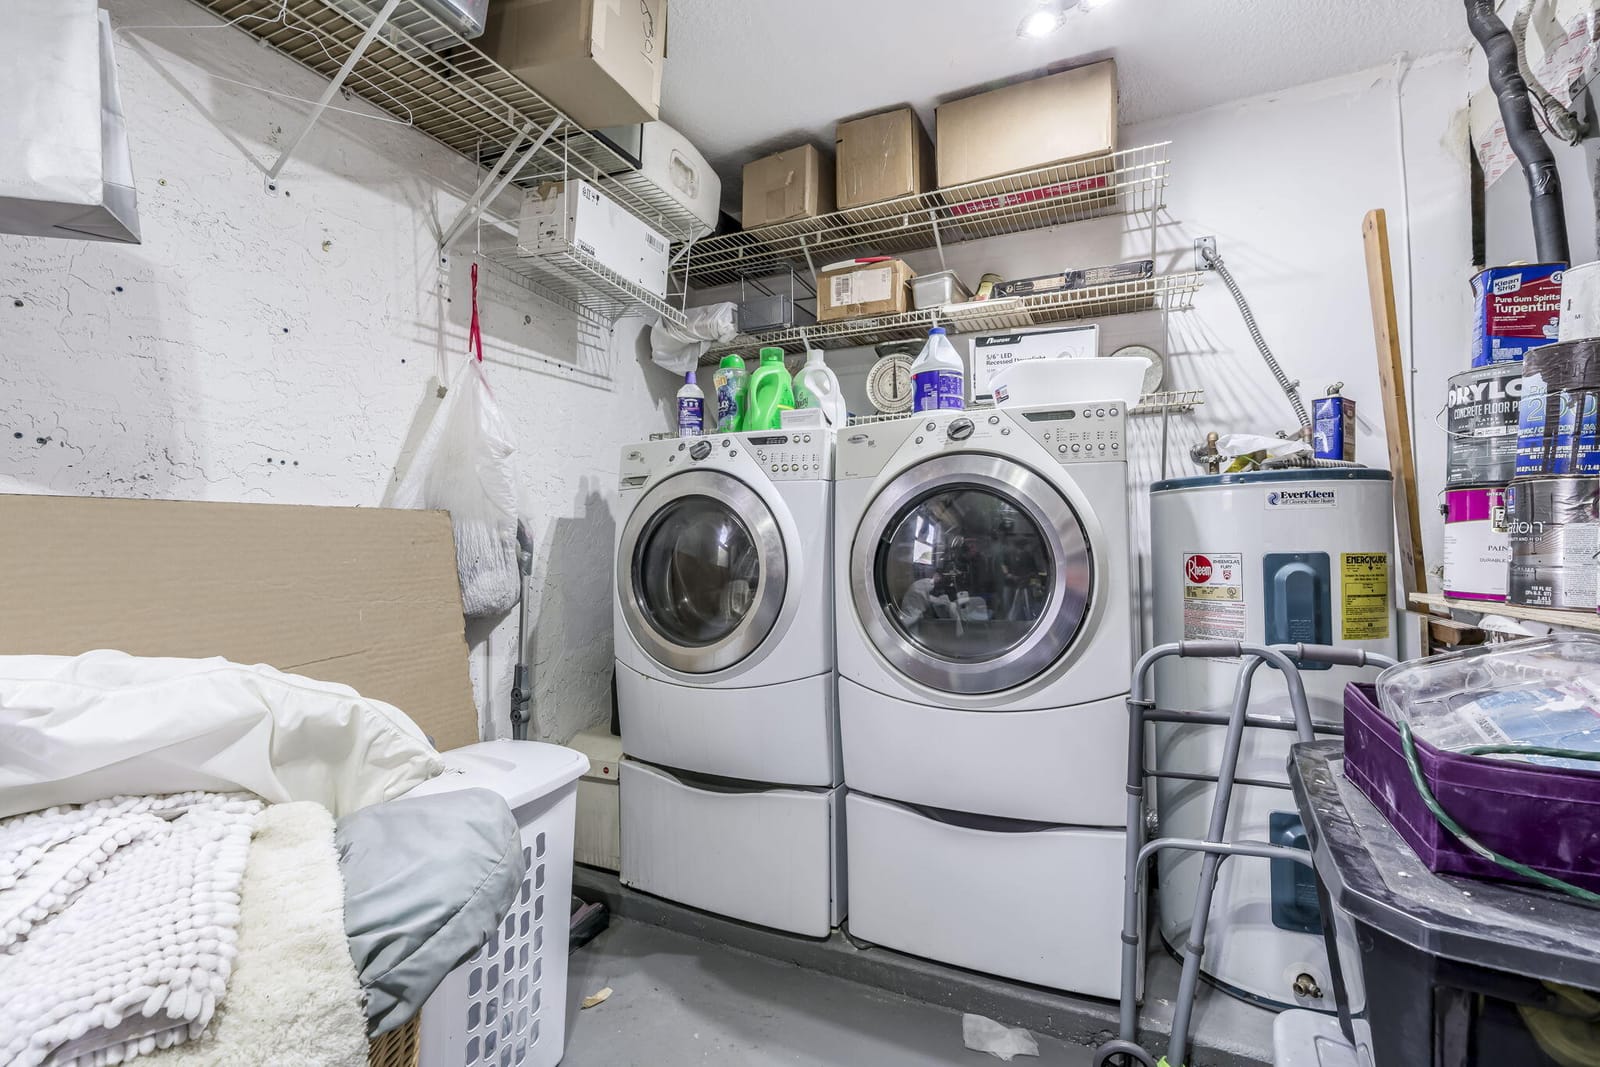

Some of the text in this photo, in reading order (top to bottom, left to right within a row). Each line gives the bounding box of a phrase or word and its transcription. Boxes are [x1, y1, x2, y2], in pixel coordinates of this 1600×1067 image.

[1494, 278, 1520, 288] Klean
[1497, 284, 1516, 292] Strip
[1513, 295, 1532, 303] Gum
[1533, 294, 1561, 303] Spirits
[1493, 301, 1561, 315] Turpentine
[985, 358, 1013, 366] Recessed
[1448, 378, 1522, 408] DRYLO
[1454, 405, 1483, 420] CONCRETE
[1484, 401, 1510, 415] FLOOR
[1280, 490, 1334, 499] EverKleen
[1188, 556, 1212, 580] Rheem
